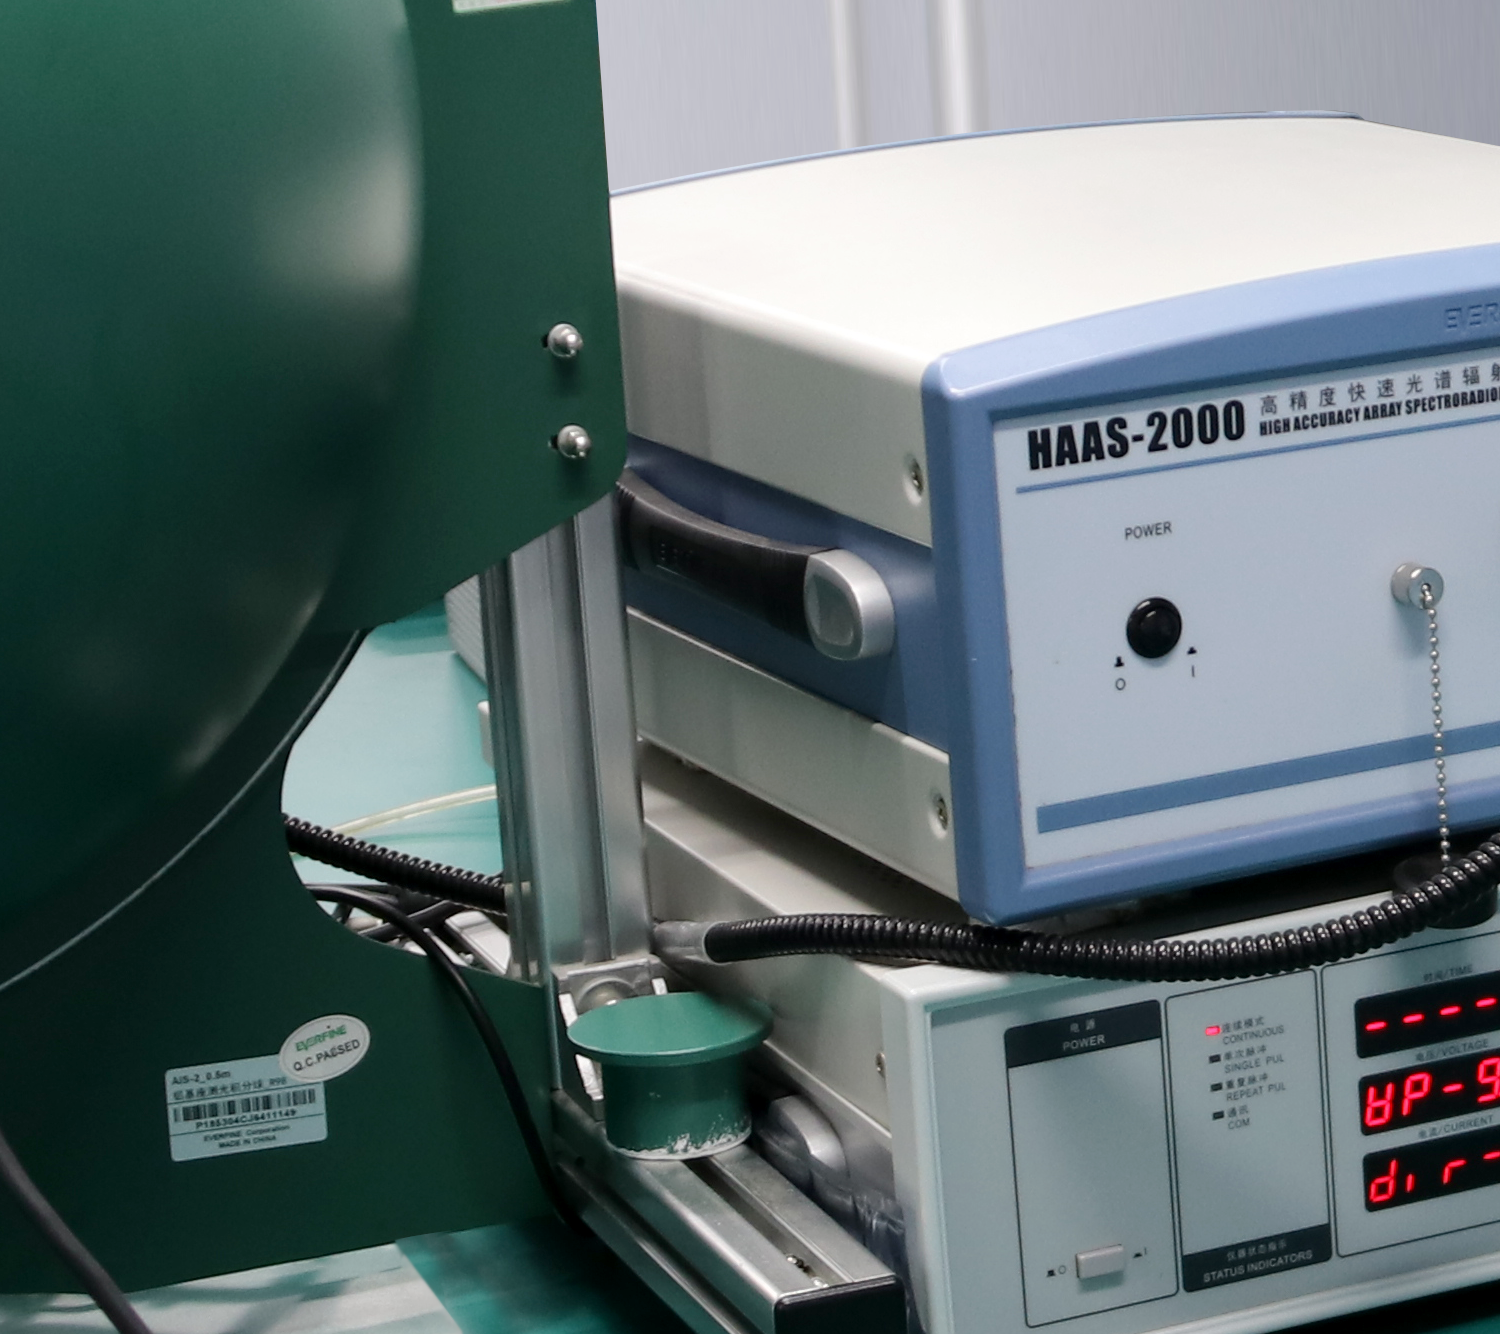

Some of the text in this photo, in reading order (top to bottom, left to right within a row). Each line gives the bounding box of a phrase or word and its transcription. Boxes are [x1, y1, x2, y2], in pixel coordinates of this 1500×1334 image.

[1260, 418, 1290, 436] HIGH
[1293, 407, 1360, 431] ACCURACY
[1363, 401, 1401, 420] ARRAY
[1028, 400, 1245, 470] HAAS-2000
[1125, 521, 1172, 541] POWER
[295, 1025, 347, 1052] EVERFINE
[1063, 1034, 1105, 1052] POWER
[1223, 1025, 1284, 1045] CONTINUOUS
[1225, 1054, 1284, 1073] SINGLE PUL
[1226, 1082, 1286, 1101] REPEAT PUL
[1228, 1117, 1250, 1130] COM
[203, 1124, 290, 1143] EVERFINE Corporation
[219, 1141, 241, 1149] MADE
[1203, 1249, 1313, 1284] STATUS INDICATORS
